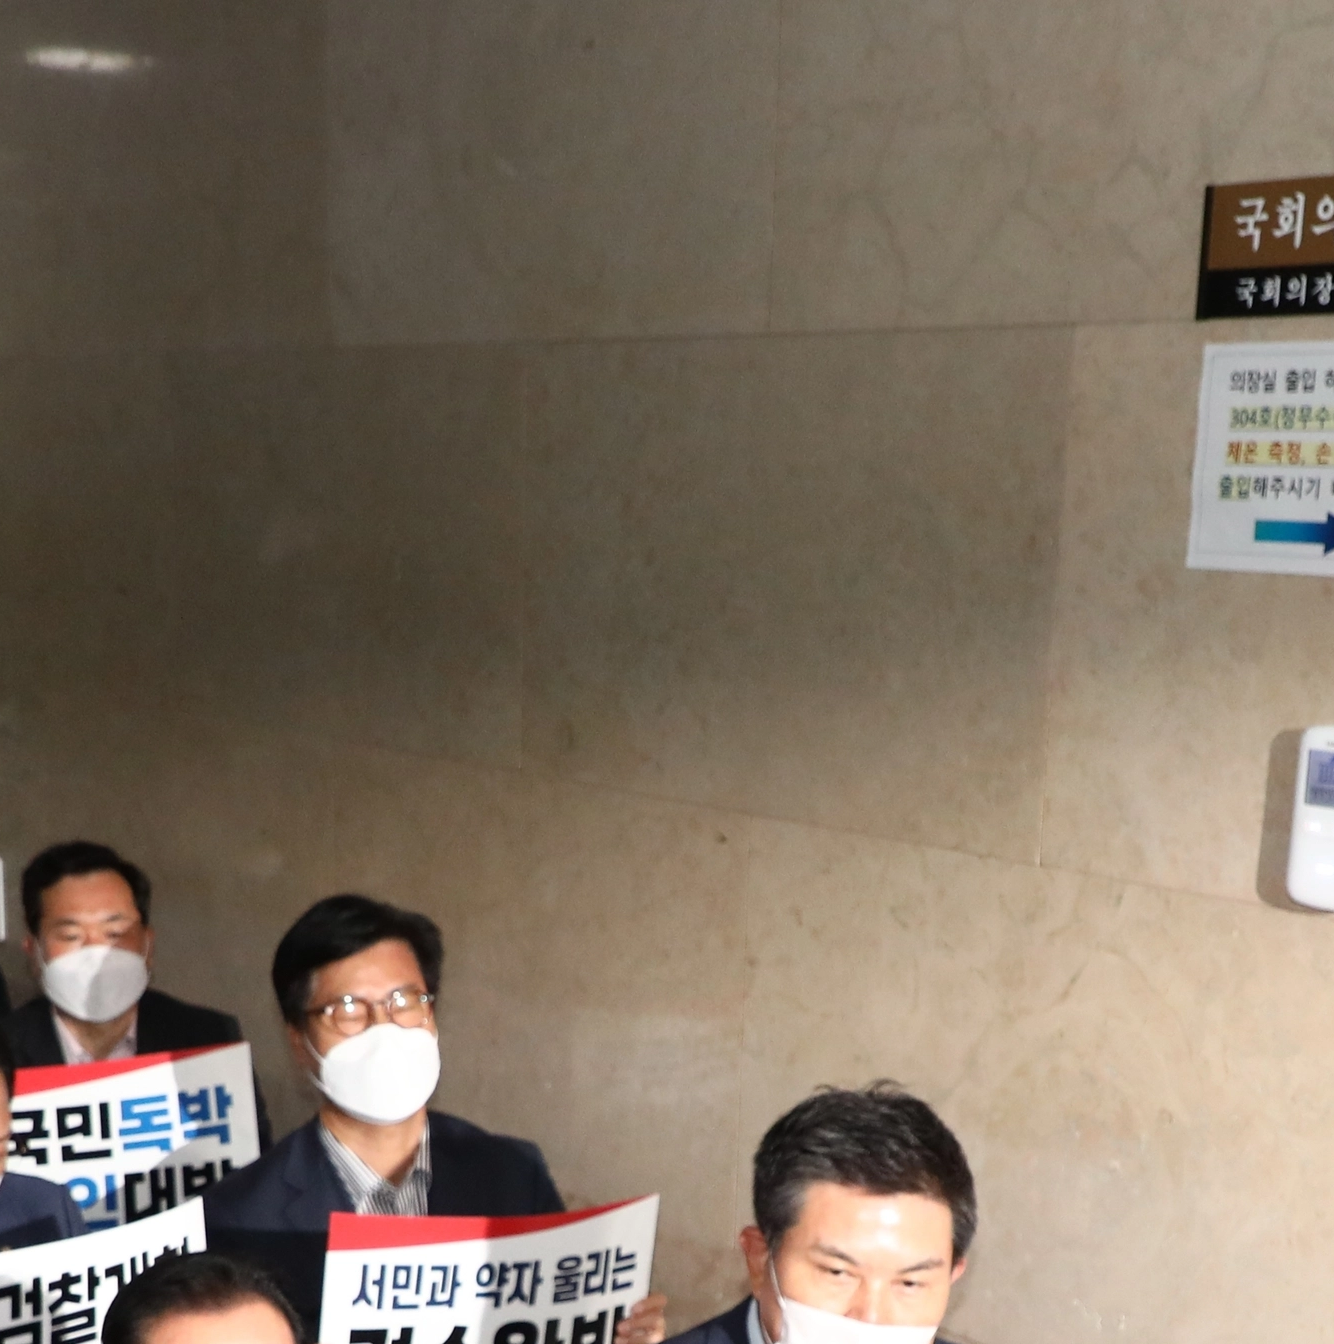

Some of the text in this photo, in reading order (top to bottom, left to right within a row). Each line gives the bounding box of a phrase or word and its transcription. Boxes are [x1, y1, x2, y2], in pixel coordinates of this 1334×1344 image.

[1230, 369, 1277, 393] 의장실
[1285, 369, 1317, 394] 출입
[1219, 474, 1321, 500] 출입해주시기
[8, 1084, 233, 1165] 국민독박
[352, 1247, 636, 1310] 서민과 약자 울리는
